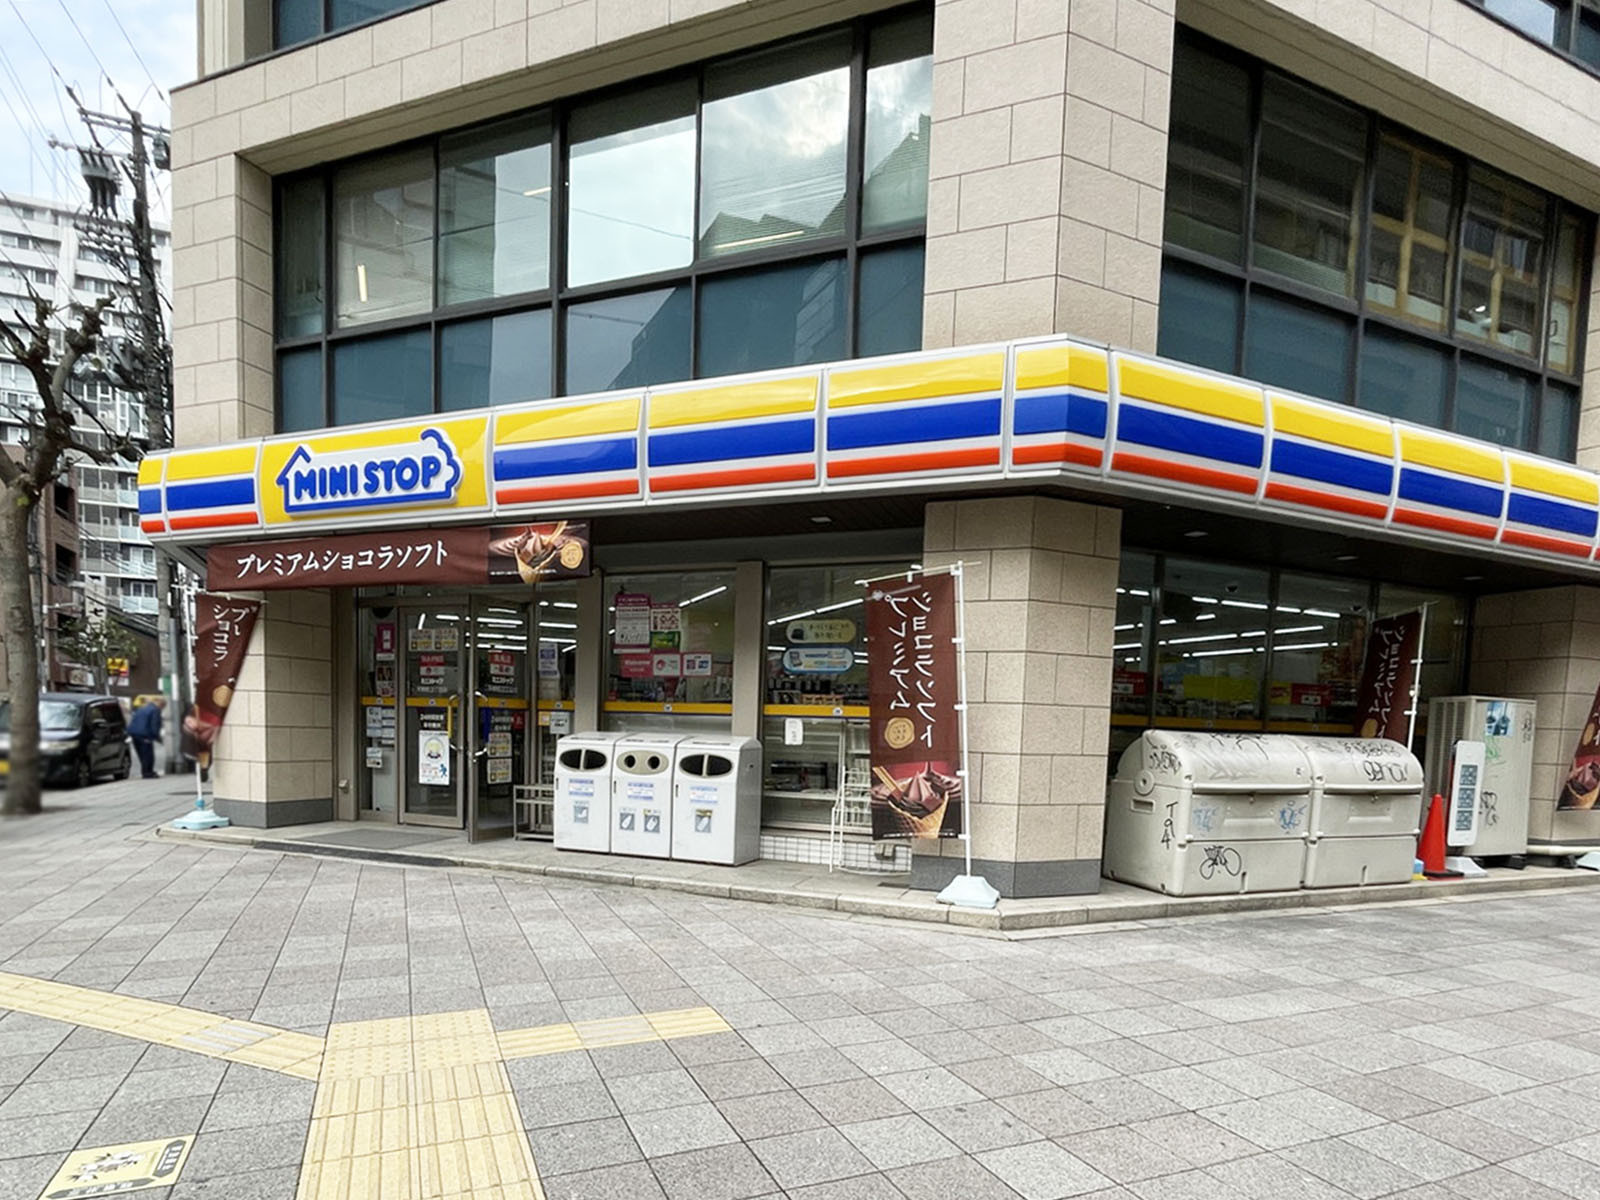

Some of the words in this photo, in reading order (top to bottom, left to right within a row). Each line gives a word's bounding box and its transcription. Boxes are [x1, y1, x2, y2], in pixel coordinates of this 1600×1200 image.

[294, 463, 359, 500] MINI
[363, 455, 442, 495] STOP
[236, 540, 449, 579] プレミアムショコラソフト
